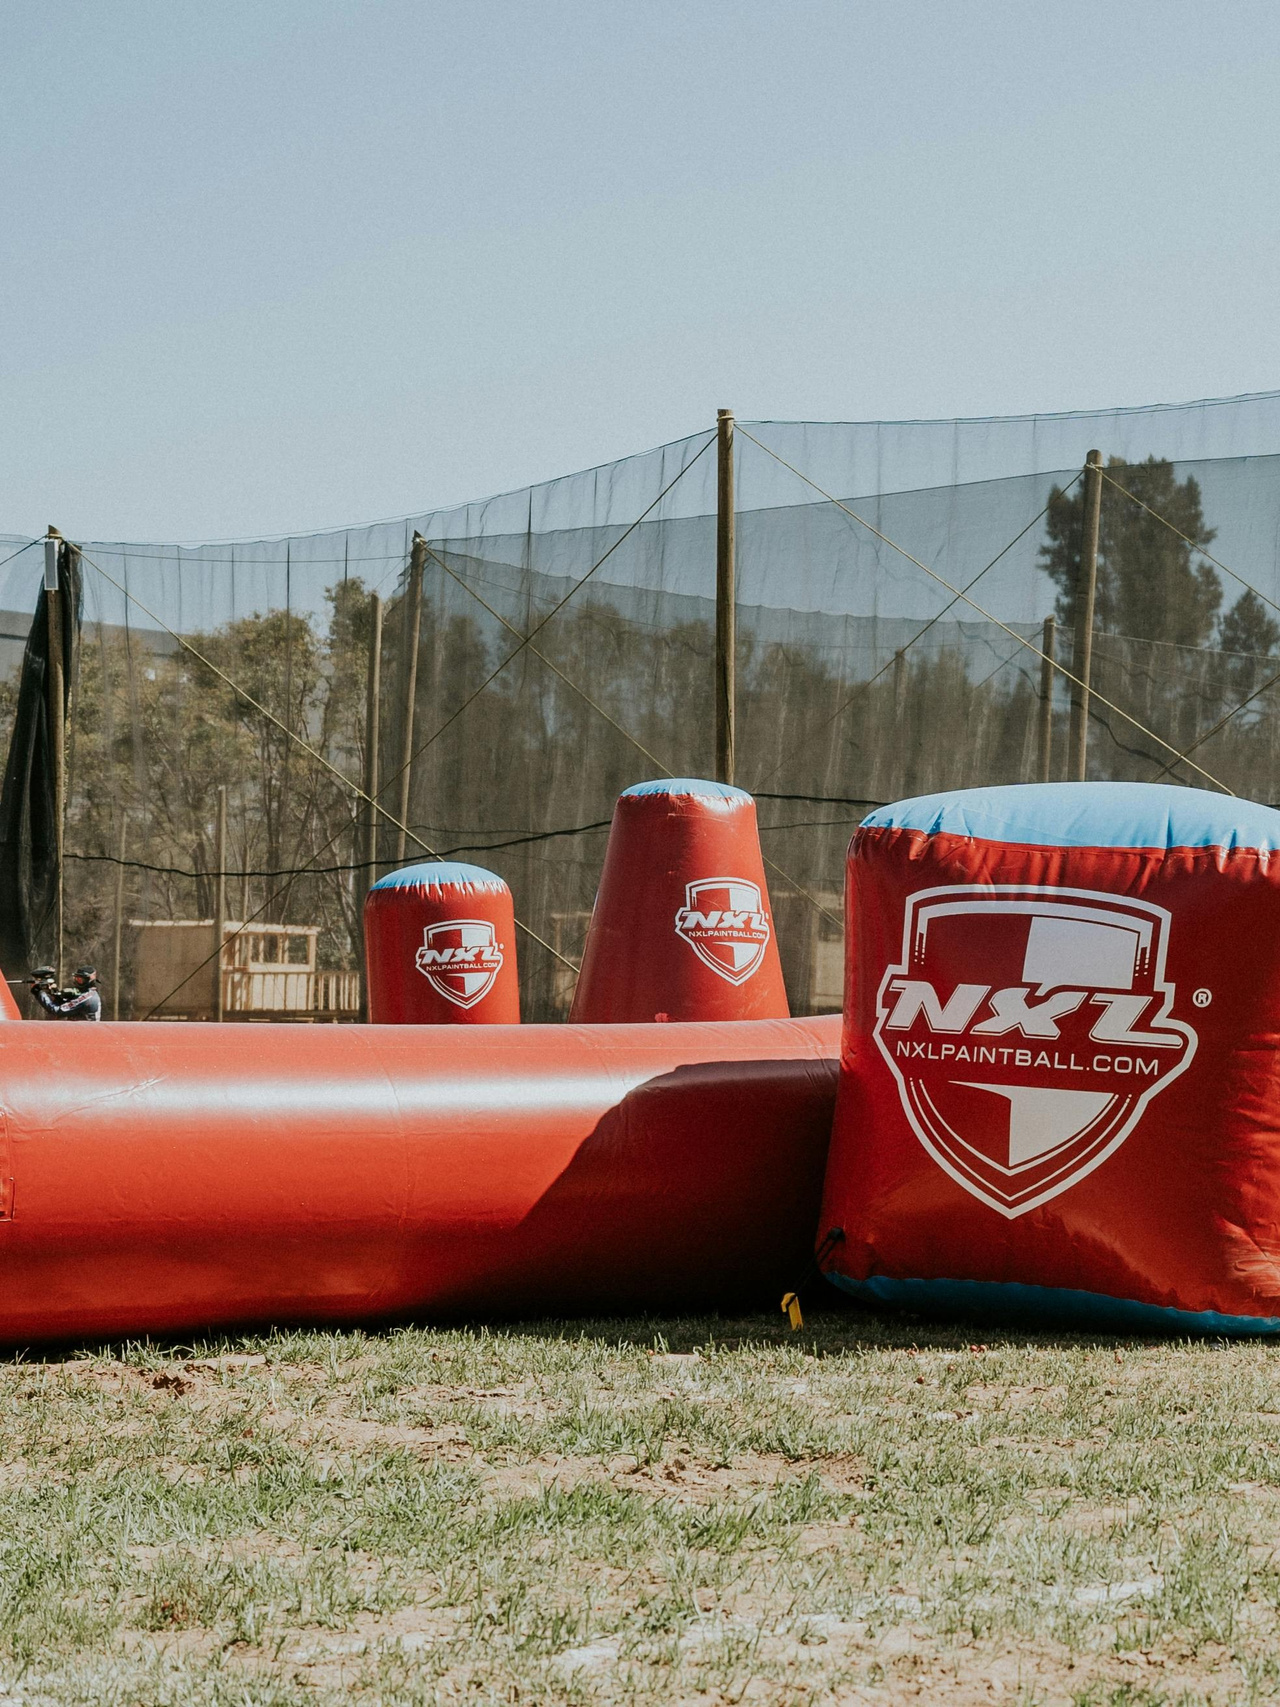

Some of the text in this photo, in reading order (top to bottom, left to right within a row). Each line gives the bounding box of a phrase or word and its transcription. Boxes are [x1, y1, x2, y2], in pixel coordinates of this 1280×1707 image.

[682, 910, 769, 931] NXL
[688, 930, 766, 939] NXLPAINTBALL.COM
[421, 947, 501, 964] NXL
[426, 962, 498, 972] NXLPAINTBALL.COM
[886, 979, 1183, 1049] NXL
[896, 1040, 1159, 1076] NXLPAINTBALL.COM
